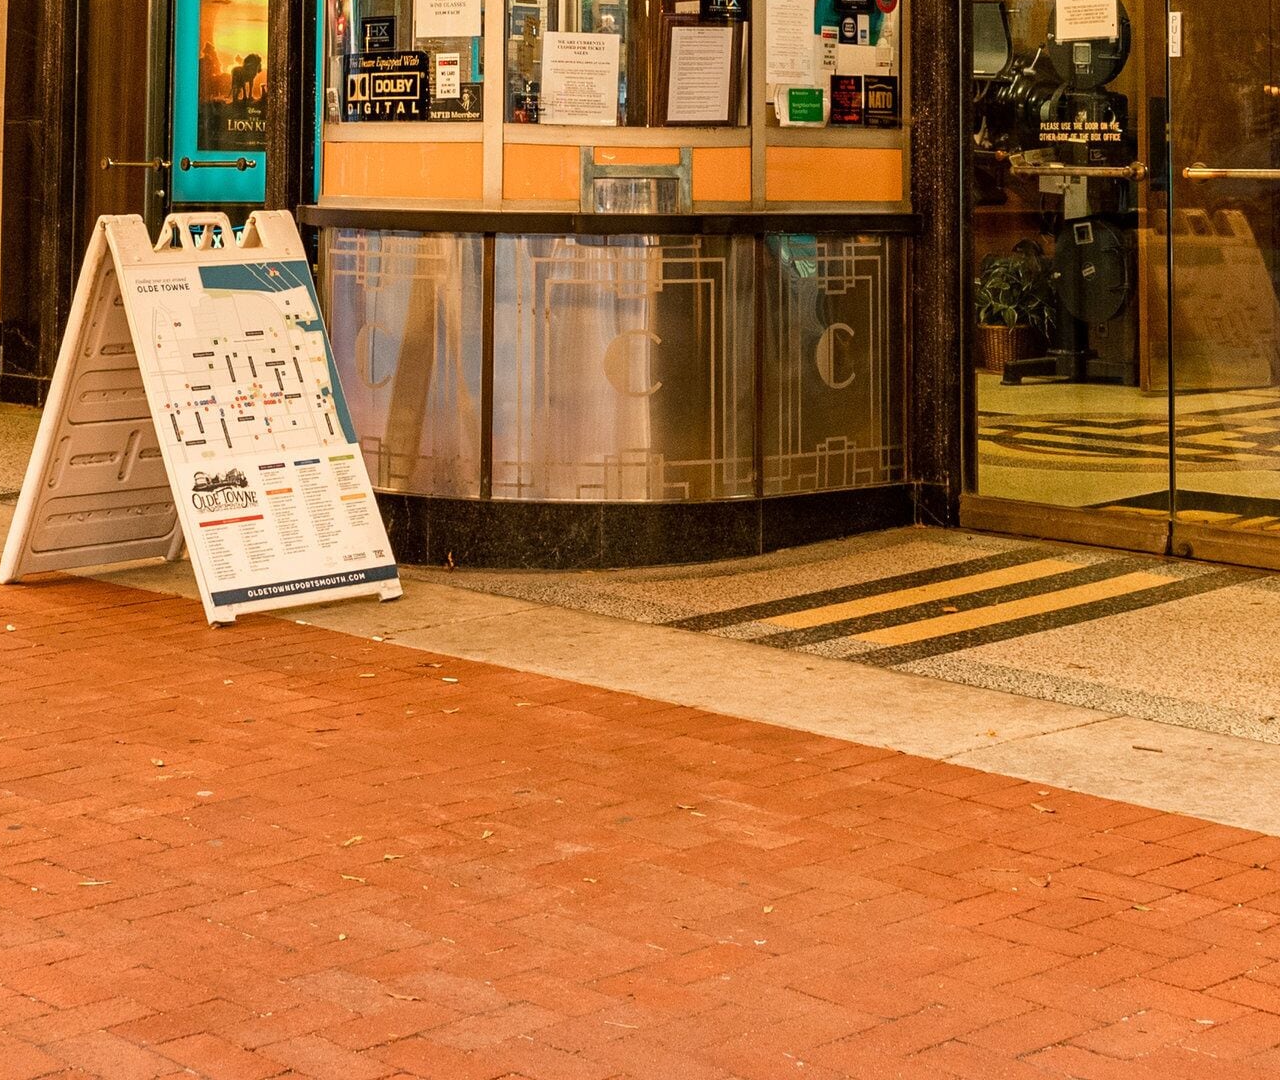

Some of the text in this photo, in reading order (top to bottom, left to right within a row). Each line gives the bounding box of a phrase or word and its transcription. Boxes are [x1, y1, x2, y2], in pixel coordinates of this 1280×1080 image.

[365, 23, 389, 39] THX
[376, 55, 403, 70] Equipped
[403, 54, 419, 66] With
[375, 78, 413, 93] DOLBY
[868, 91, 892, 108] NATO
[347, 101, 419, 115] DIGITAL
[451, 110, 480, 119] Member
[228, 119, 266, 132] LION KI
[1040, 122, 1120, 130] PLEASE USE THE DOOR ON THE
[1039, 133, 1121, 141] OTHER SIDE OF THE BOX OFFICE
[137, 283, 190, 293] OLDE TOWNE
[603, 328, 663, 397] C
[817, 322, 856, 389] C
[192, 486, 258, 512] OLDE TOWNE
[247, 572, 366, 598] OLDETOWNEPORTSMOUTH.COM
